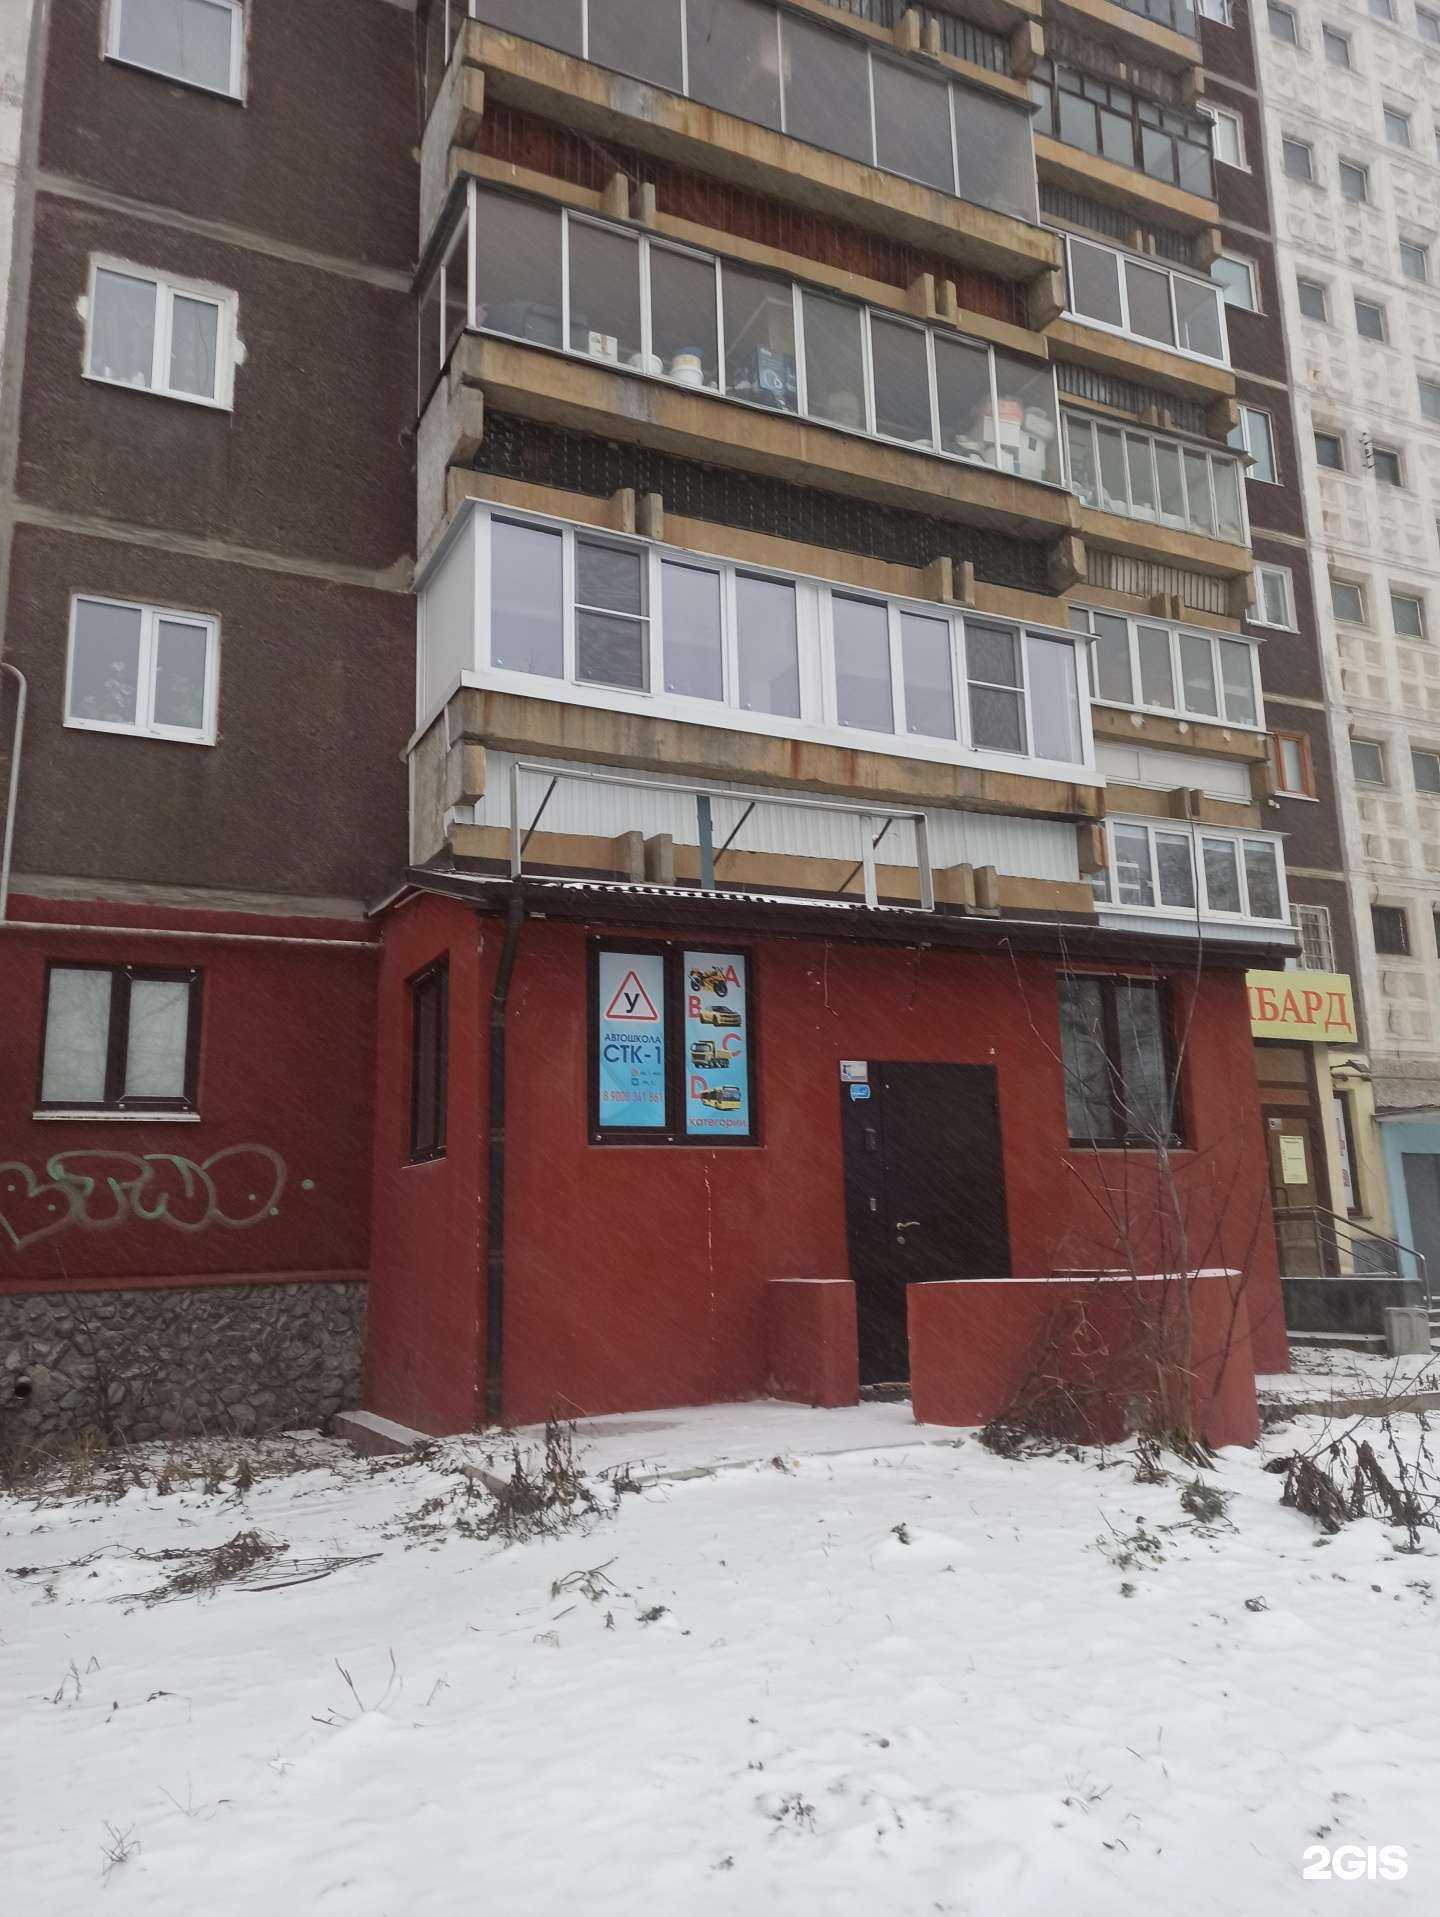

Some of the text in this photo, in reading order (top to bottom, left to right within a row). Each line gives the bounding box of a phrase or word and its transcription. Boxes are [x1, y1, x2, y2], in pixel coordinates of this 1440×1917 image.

[725, 965, 741, 988] A
[624, 993, 640, 1013] У
[688, 996, 703, 1018] B
[605, 1033, 661, 1044] АВТОШКОЛА
[691, 1075, 708, 1099] D
[689, 1117, 746, 1129] категории
